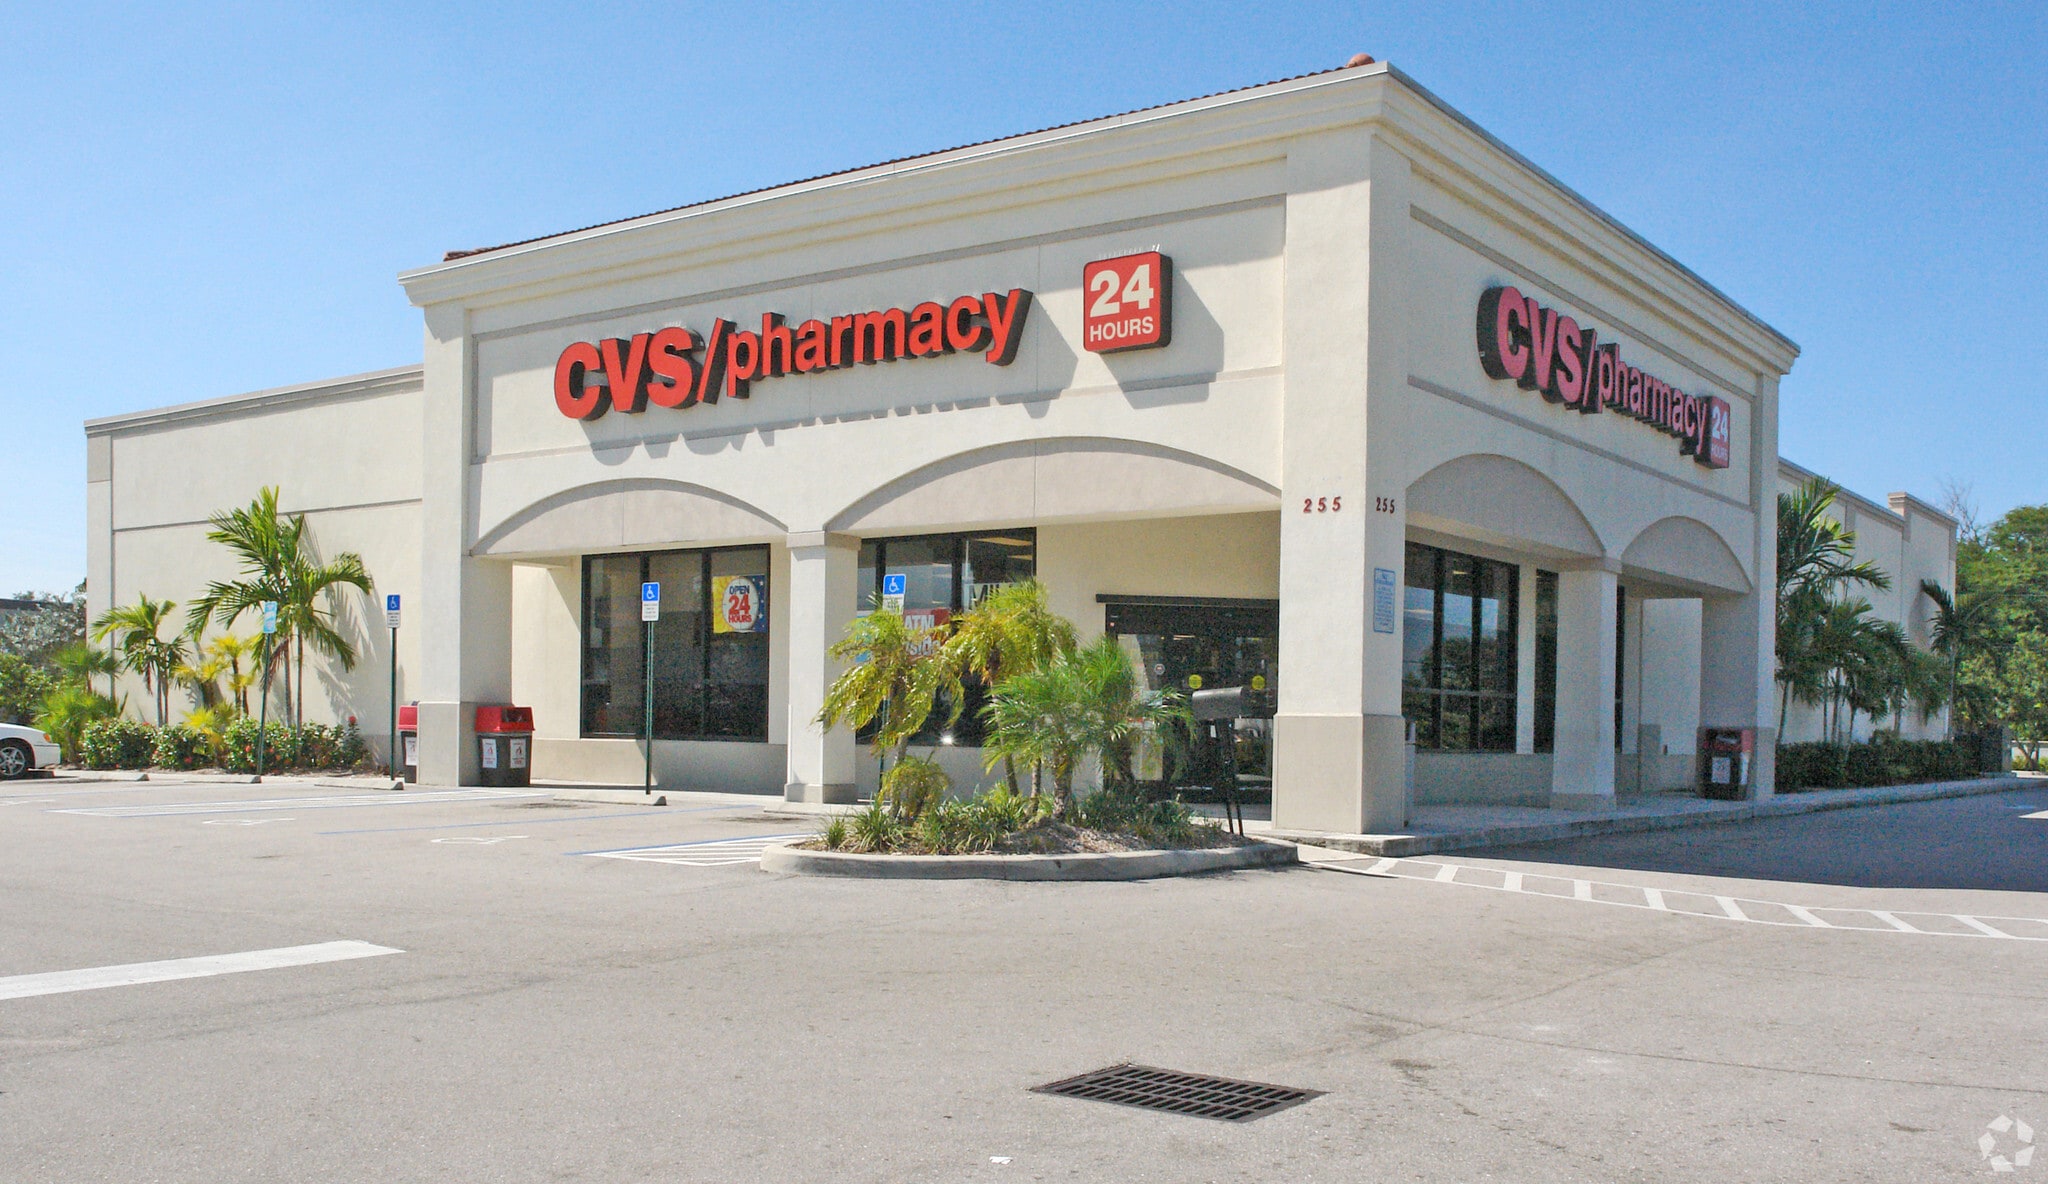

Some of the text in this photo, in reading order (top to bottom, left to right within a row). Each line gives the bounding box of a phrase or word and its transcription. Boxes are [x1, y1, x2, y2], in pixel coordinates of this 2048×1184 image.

[1089, 263, 1154, 318] 24
[1089, 316, 1154, 343] HOURS
[555, 288, 1025, 420] CVS/pharmacy
[1497, 286, 1708, 455] CVS/pharmacy
[1712, 406, 1729, 443] 24
[1303, 496, 1342, 514] 255
[1376, 496, 1395, 514] 255
[729, 585, 750, 595] OPEN
[728, 594, 751, 615] 24
[728, 613, 752, 623] HOURS
[904, 614, 935, 632] ATM
